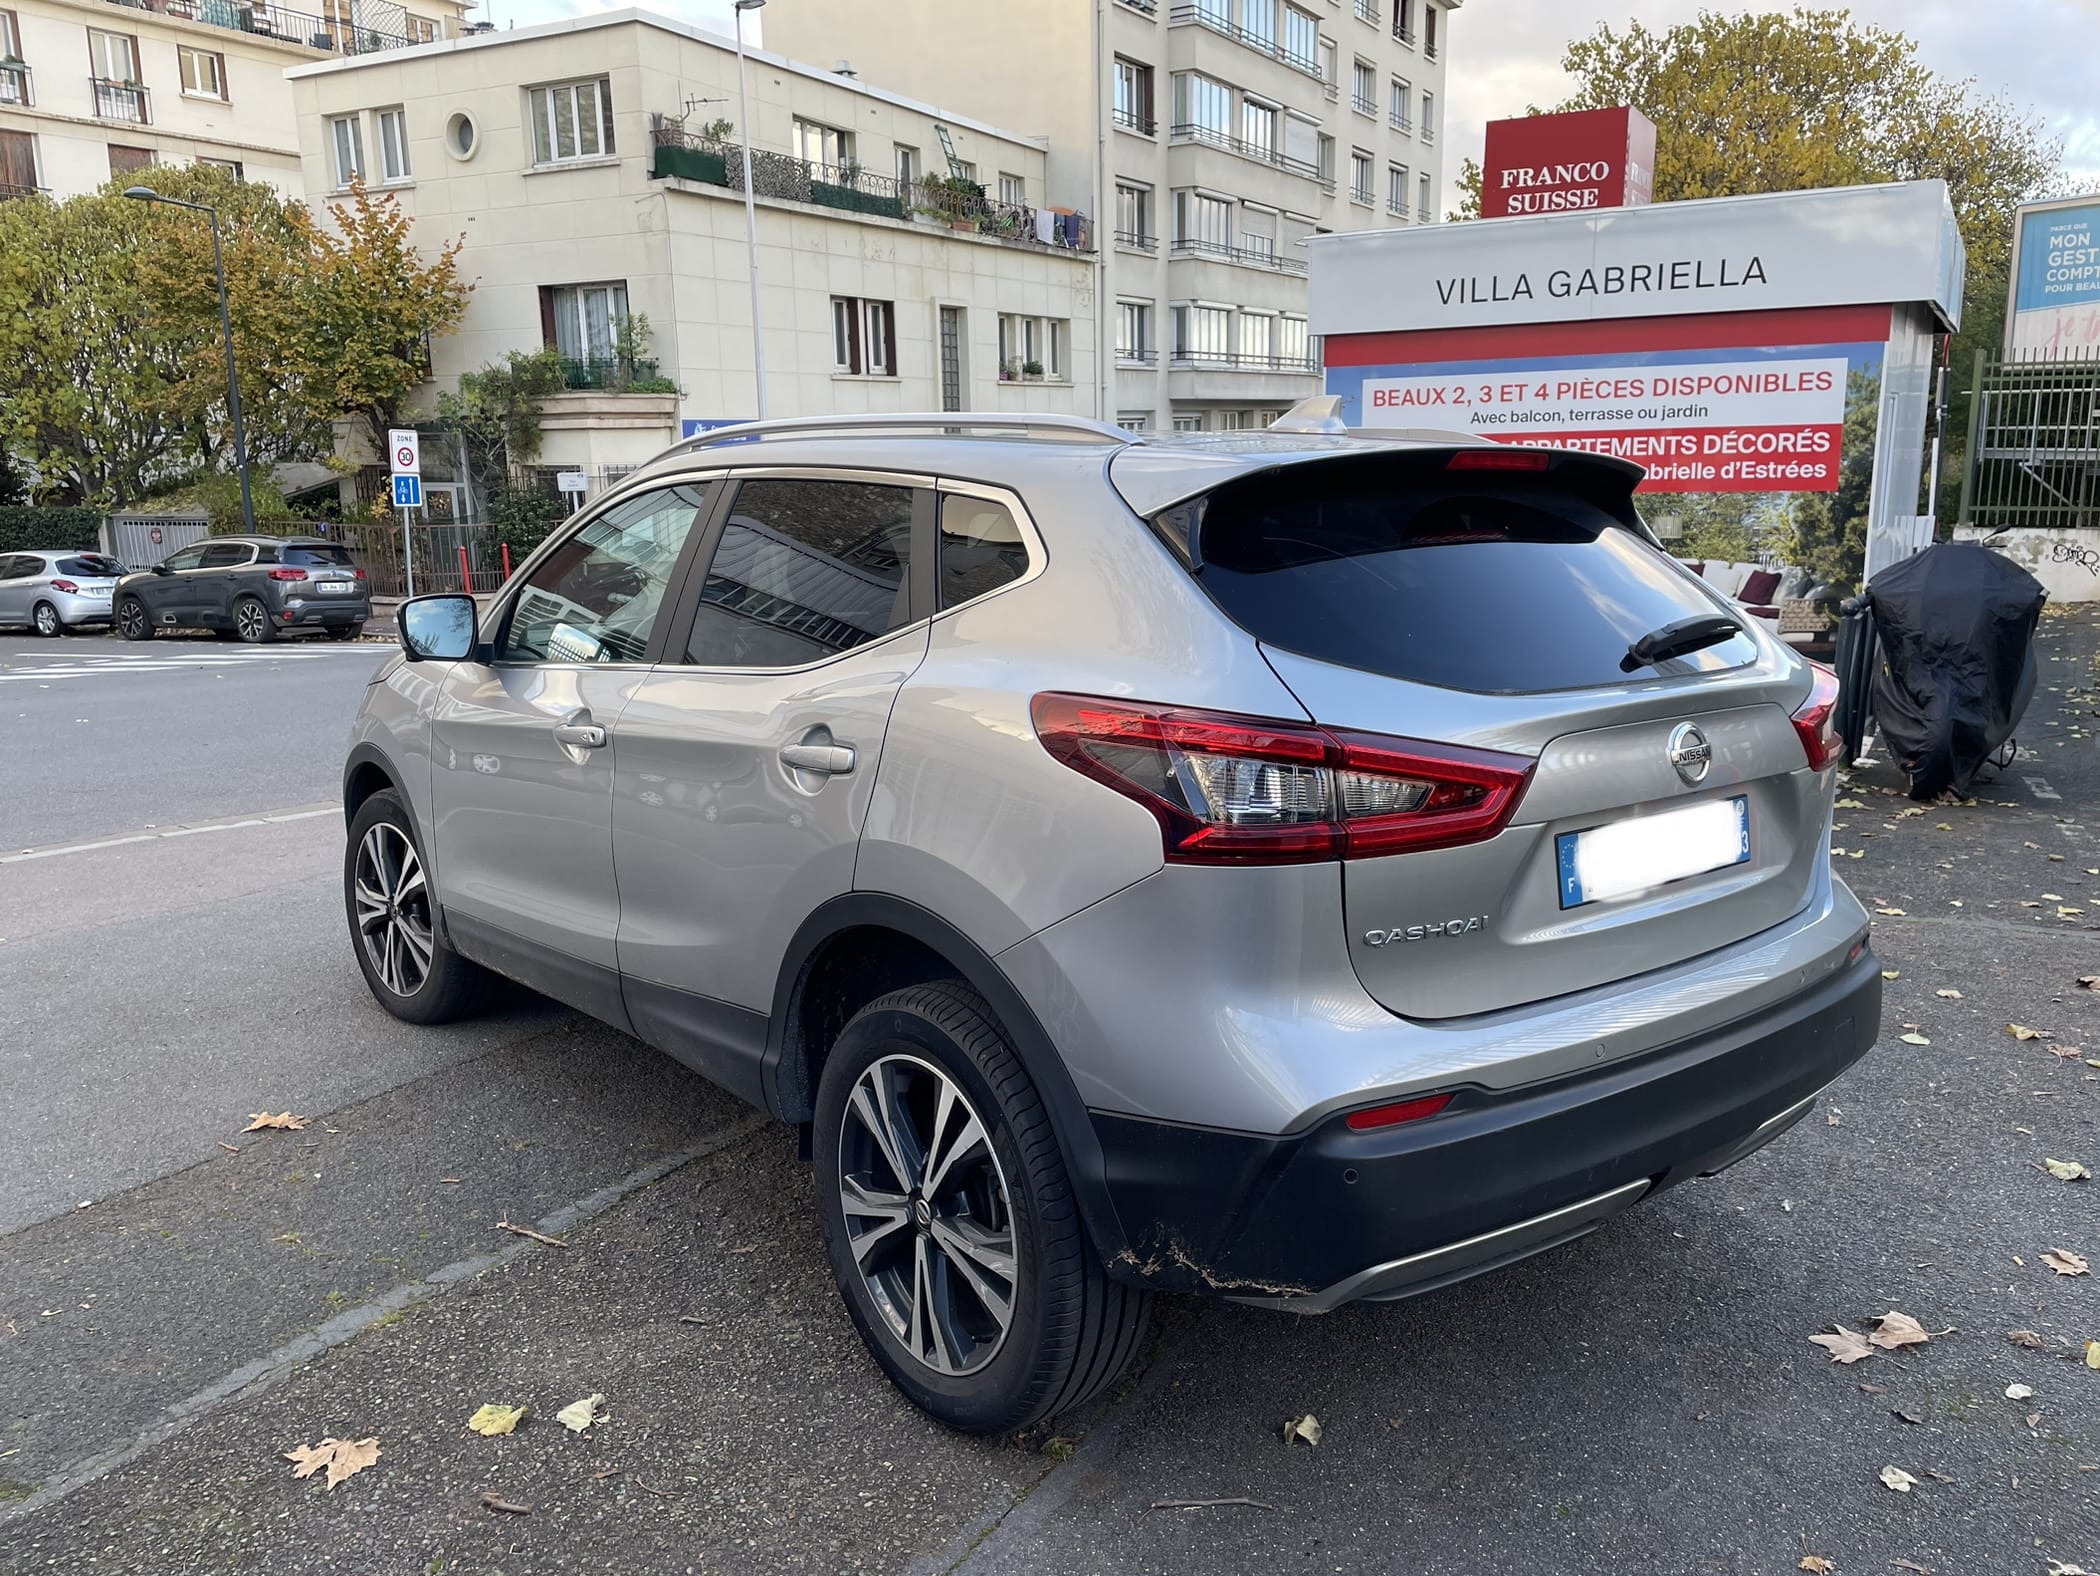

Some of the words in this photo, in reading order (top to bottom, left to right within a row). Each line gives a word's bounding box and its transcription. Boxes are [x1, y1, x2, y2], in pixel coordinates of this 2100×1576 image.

[1500, 161, 1610, 189] FRANCO
[1507, 188, 1599, 214] SUISSE
[2049, 232, 2091, 249] MON
[2048, 248, 2100, 267] GEST
[1436, 273, 1534, 305] VILLA
[1547, 256, 1768, 298] GABRIELLA
[2045, 283, 2073, 294] POUR
[1373, 387, 1447, 407] BEAUX
[1452, 386, 1472, 408] 2,
[1479, 385, 1493, 404] 3
[1500, 383, 1529, 403] ET
[1534, 383, 1549, 401] 4
[1556, 377, 1645, 401] PIÈCES
[1652, 371, 1833, 398] DISPONIBLES
[1470, 411, 1506, 424] Avec
[1510, 409, 1565, 424] balcon,
[1569, 408, 1634, 422] terrasse
[1637, 408, 1657, 419] ou
[1661, 404, 1708, 421] jardin
[1703, 428, 1830, 455] DÉCORÉS
[401, 452, 411, 462] 30
[1642, 462, 1716, 480] abrielle
[1720, 460, 1827, 480] d'Estrées
[1679, 745, 1711, 762] NISSAN
[1568, 878, 1575, 894] F
[1363, 915, 1489, 948] QASHQAI
